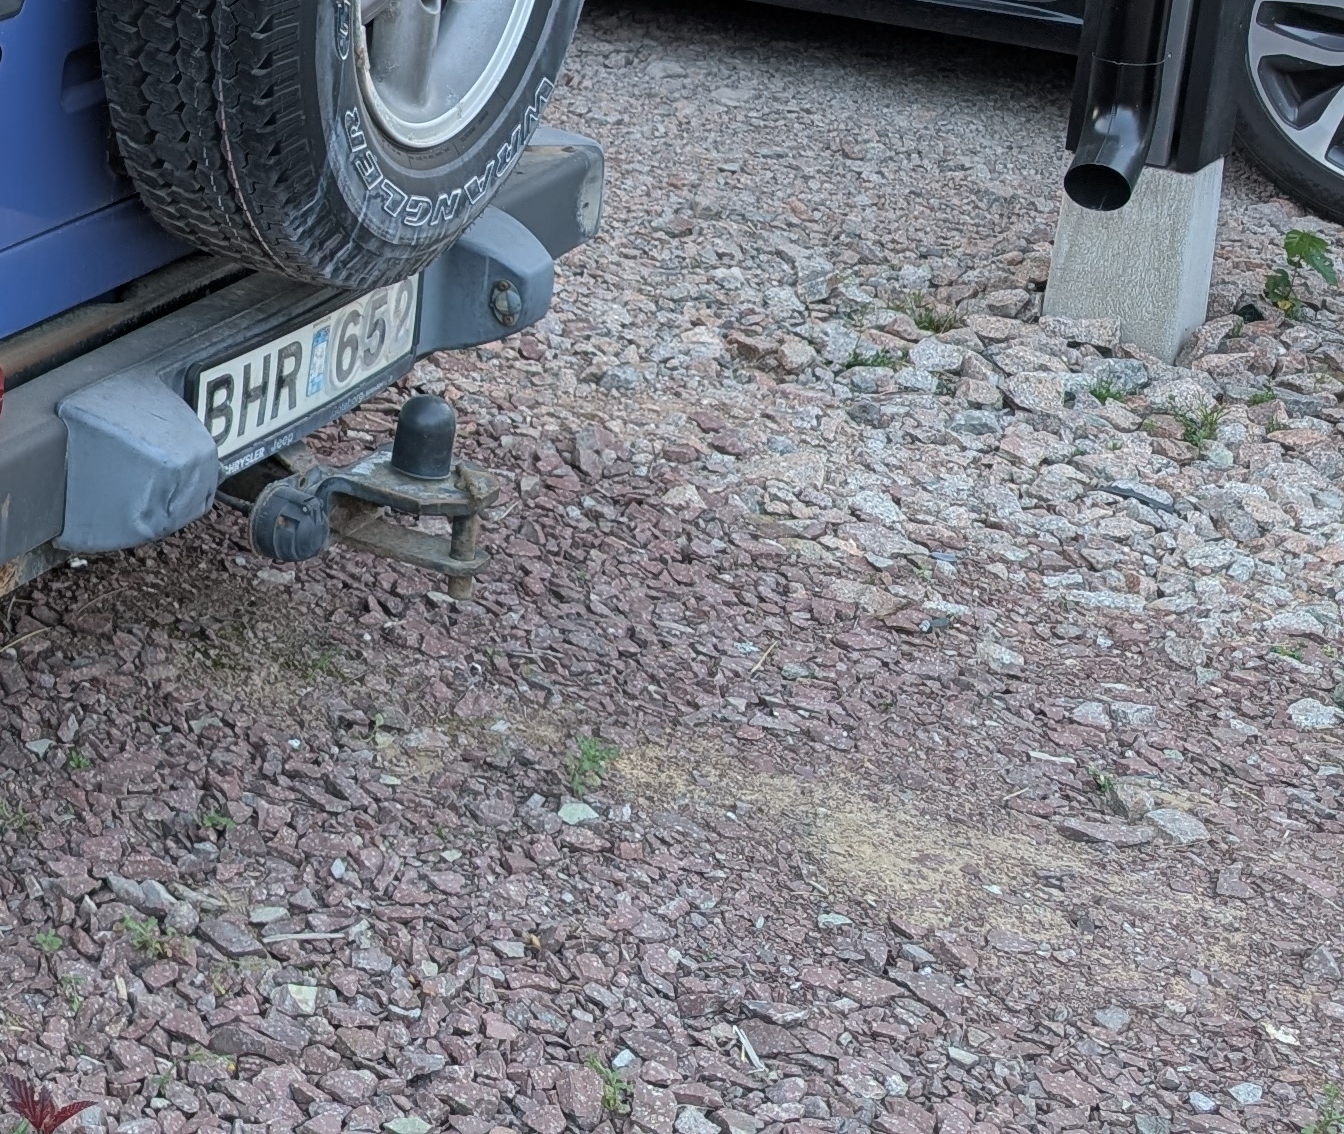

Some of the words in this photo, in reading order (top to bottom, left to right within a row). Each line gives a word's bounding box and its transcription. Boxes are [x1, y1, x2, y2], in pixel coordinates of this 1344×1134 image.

[345, 77, 555, 227] WRANGLER
[205, 340, 302, 447] BHR
[269, 432, 295, 451] Jeep
